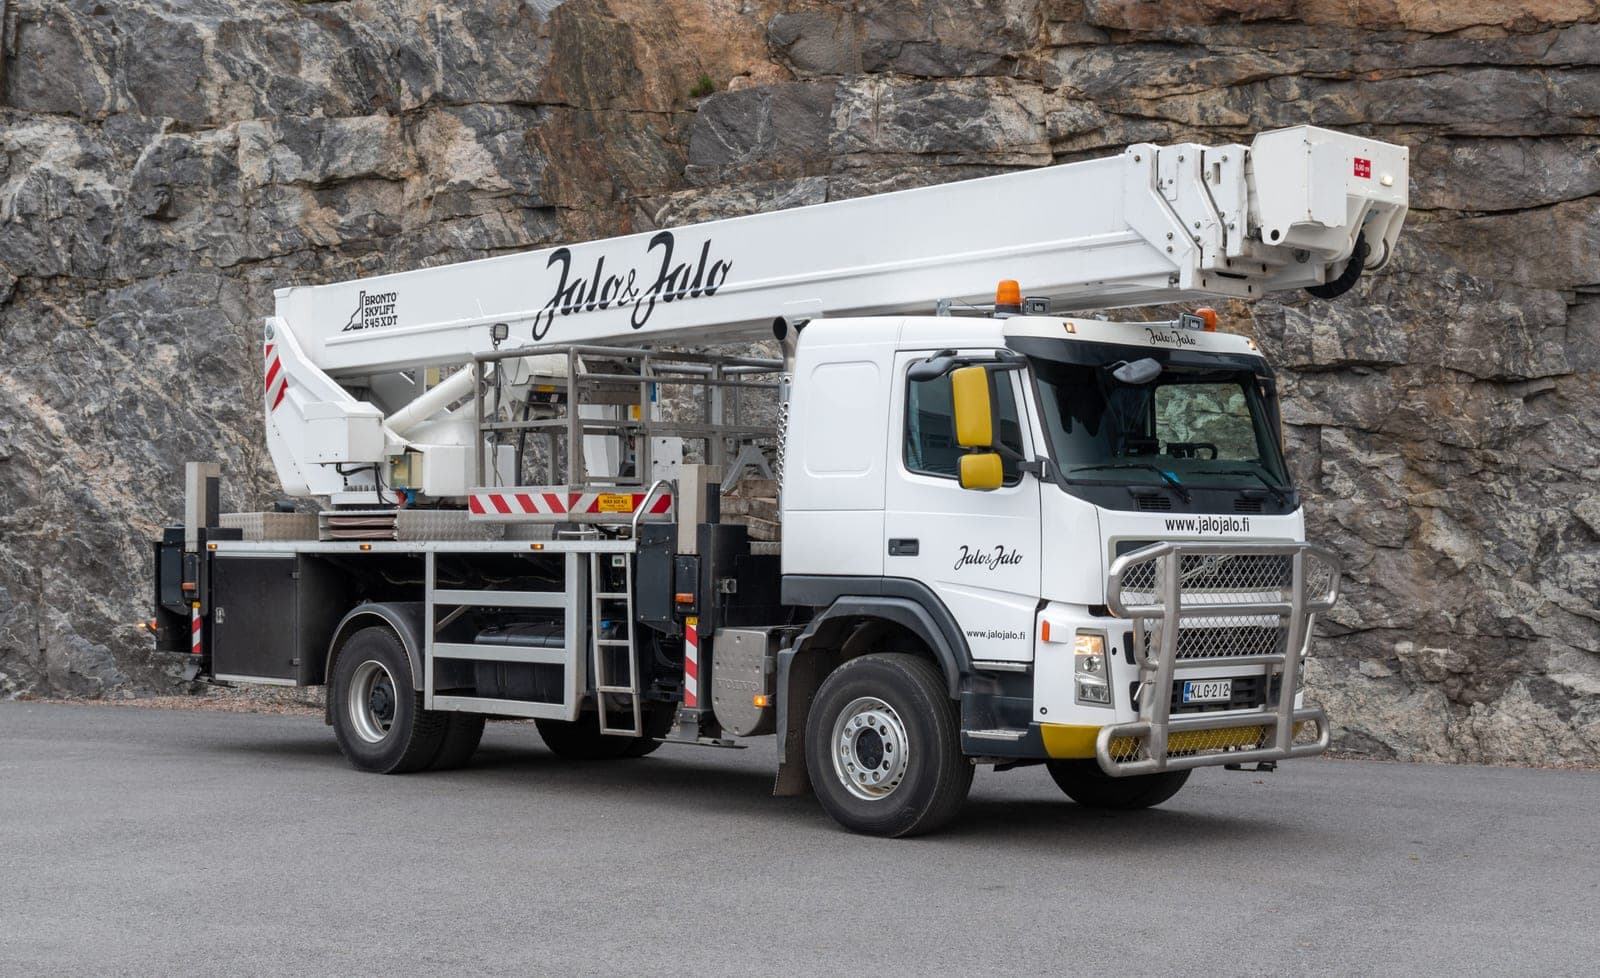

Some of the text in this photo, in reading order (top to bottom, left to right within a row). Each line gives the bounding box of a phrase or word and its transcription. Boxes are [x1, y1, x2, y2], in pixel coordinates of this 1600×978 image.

[364, 292, 397, 306] BRONTO
[364, 304, 396, 317] SKYLIFT
[1165, 516, 1250, 535] www.jalojalo.fi
[966, 629, 1026, 641] www.jalojalo.fi
[1190, 683, 1230, 699] KLG-212
